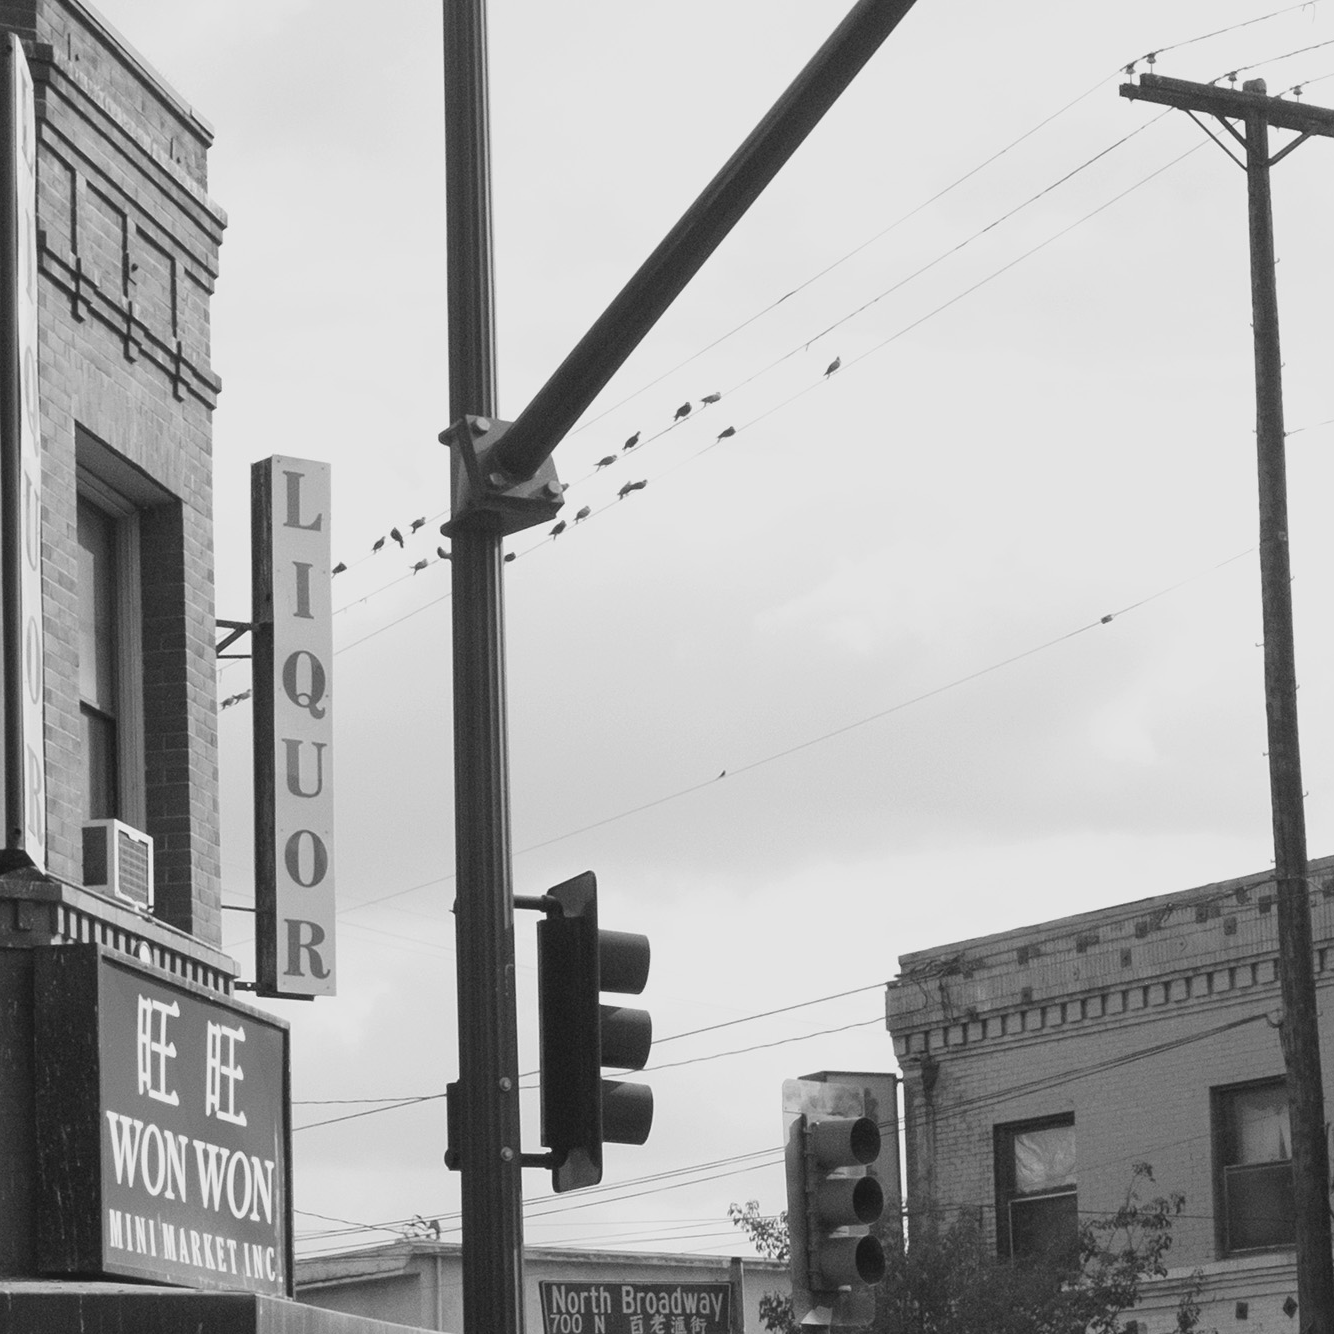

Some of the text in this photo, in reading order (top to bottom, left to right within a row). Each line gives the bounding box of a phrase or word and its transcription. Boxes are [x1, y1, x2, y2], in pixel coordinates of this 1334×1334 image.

[281, 469, 331, 981] LIQUOR
[136, 993, 248, 1127] 旺旺
[106, 1110, 275, 1225] WON WON
[109, 1208, 284, 1283] MINI MARKET INC.
[550, 1314, 583, 1334] 700
[594, 1315, 606, 1334] N
[551, 1285, 724, 1322] North Broadway
